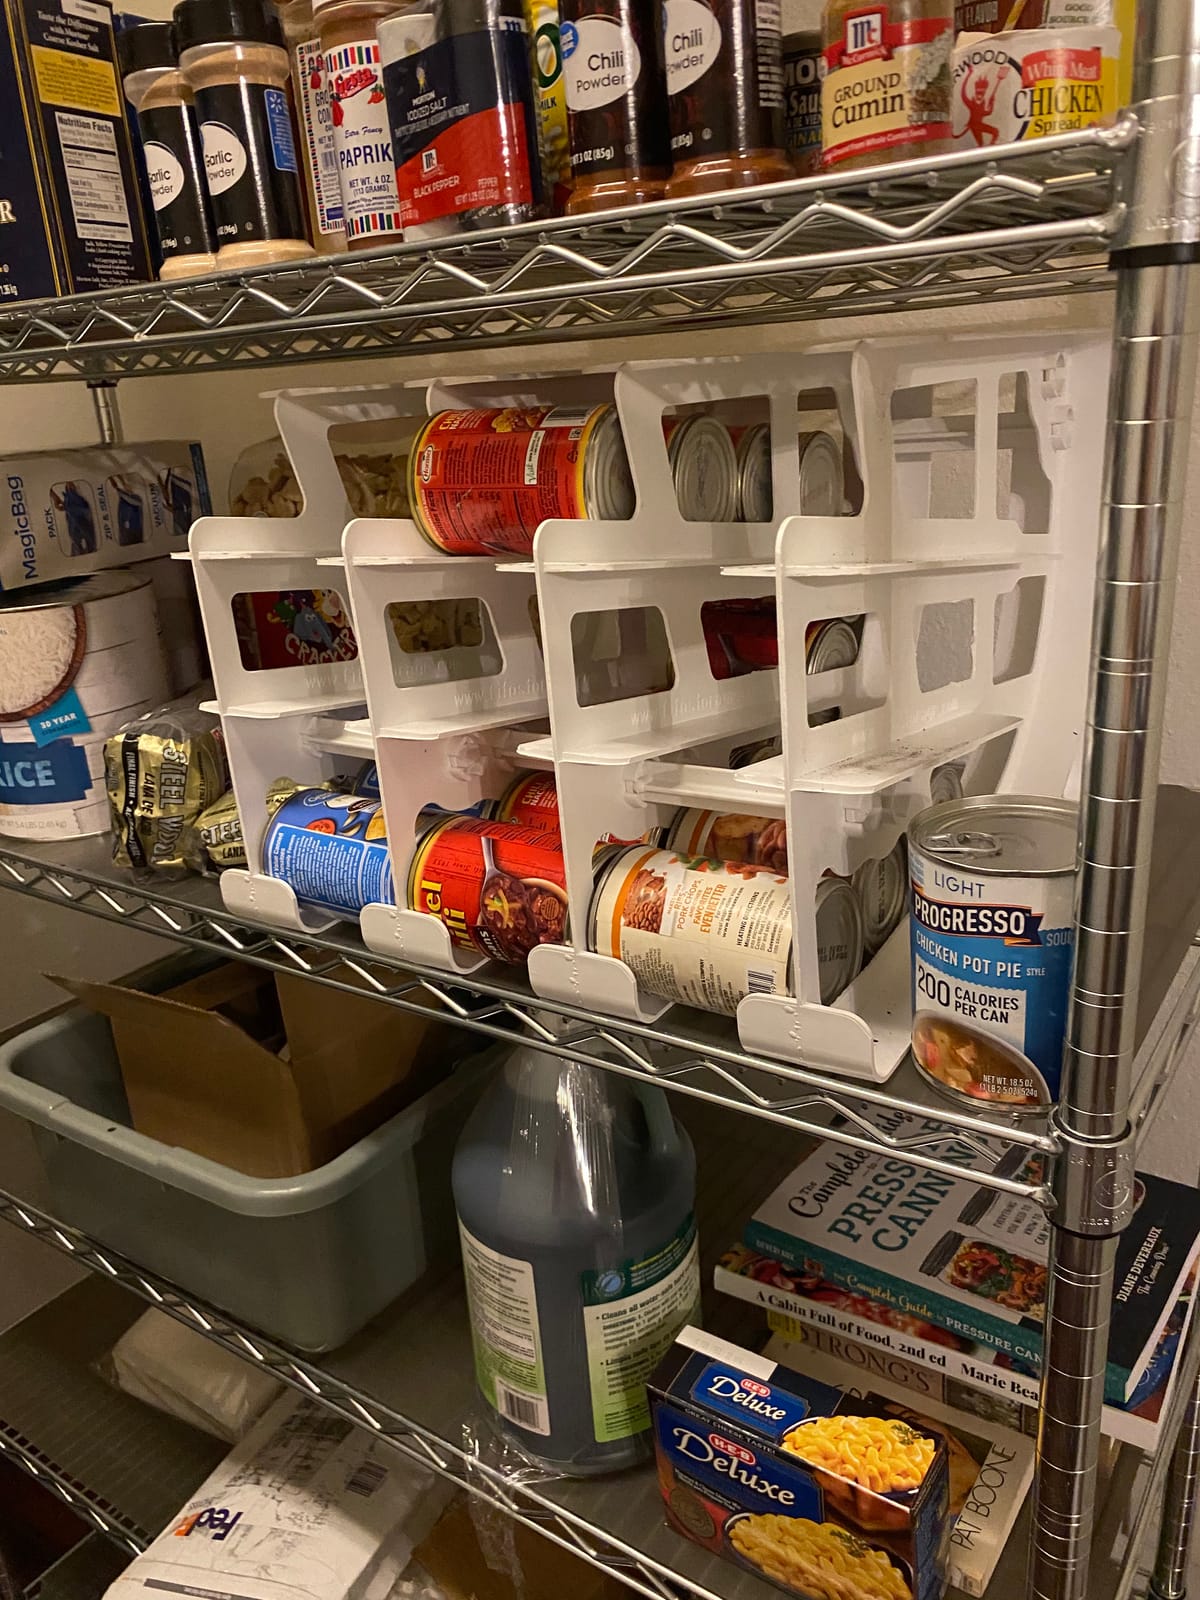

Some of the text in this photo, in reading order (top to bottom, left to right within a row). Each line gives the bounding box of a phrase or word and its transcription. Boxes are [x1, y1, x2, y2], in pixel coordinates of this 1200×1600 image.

[672, 28, 703, 53] Chili
[588, 50, 624, 71] Chili
[1070, 62, 1098, 80] Meat
[577, 73, 625, 93] Powder
[834, 72, 901, 103] GROUND
[430, 96, 447, 112] SALT
[832, 90, 905, 129] Cumin
[1013, 84, 1104, 119] CHICKEN
[57, 116, 113, 134] Nutrition Facts
[1033, 115, 1081, 136] Spread
[593, 146, 614, 161] (85g)
[349, 178, 359, 189] NET
[361, 177, 374, 188] WT.
[365, 183, 390, 196] GRAMS)
[413, 175, 460, 199] BLACK PEPPER
[8, 475, 39, 580] MagicBag
[44, 508, 56, 539] PACK
[40, 719, 52, 730] 30
[53, 712, 77, 726] YEAR
[143, 772, 156, 798] LANA
[159, 746, 188, 809] STEEL
[141, 801, 154, 816] DE
[934, 870, 985, 899] LIGHT
[693, 886, 713, 924] FAVORITES
[700, 911, 714, 933] EVEN
[710, 884, 728, 912] BETTER
[914, 894, 1025, 936] PROGRESSO
[677, 908, 686, 930] PORK
[736, 920, 748, 946] HEATING
[916, 930, 1046, 979] CHICKEN POT PIE STYLE
[917, 965, 950, 1008] 200
[954, 986, 1019, 1011] CALORIES
[954, 1001, 1009, 1024] PER CAN
[983, 1074, 995, 1084] NET
[788, 1149, 872, 1219] Complete
[1116, 1225, 1163, 1304] DIANE DEVEREAUX
[1137, 1278, 1151, 1296] The
[602, 1309, 627, 1320] Cleans
[629, 1303, 639, 1312] all
[846, 1272, 897, 1305] Complete
[899, 1294, 934, 1320] Guide
[945, 1316, 1013, 1352] PRESSURE
[755, 1289, 1041, 1402] A Cabin Full of Food, 2nd ed Marie Bea
[706, 1375, 788, 1421] Deluxe
[685, 1407, 712, 1423] GREAT
[713, 1420, 747, 1441] CHEESE
[672, 1427, 796, 1506] Deluxe
[950, 1445, 1017, 1551] PAT BOONE
